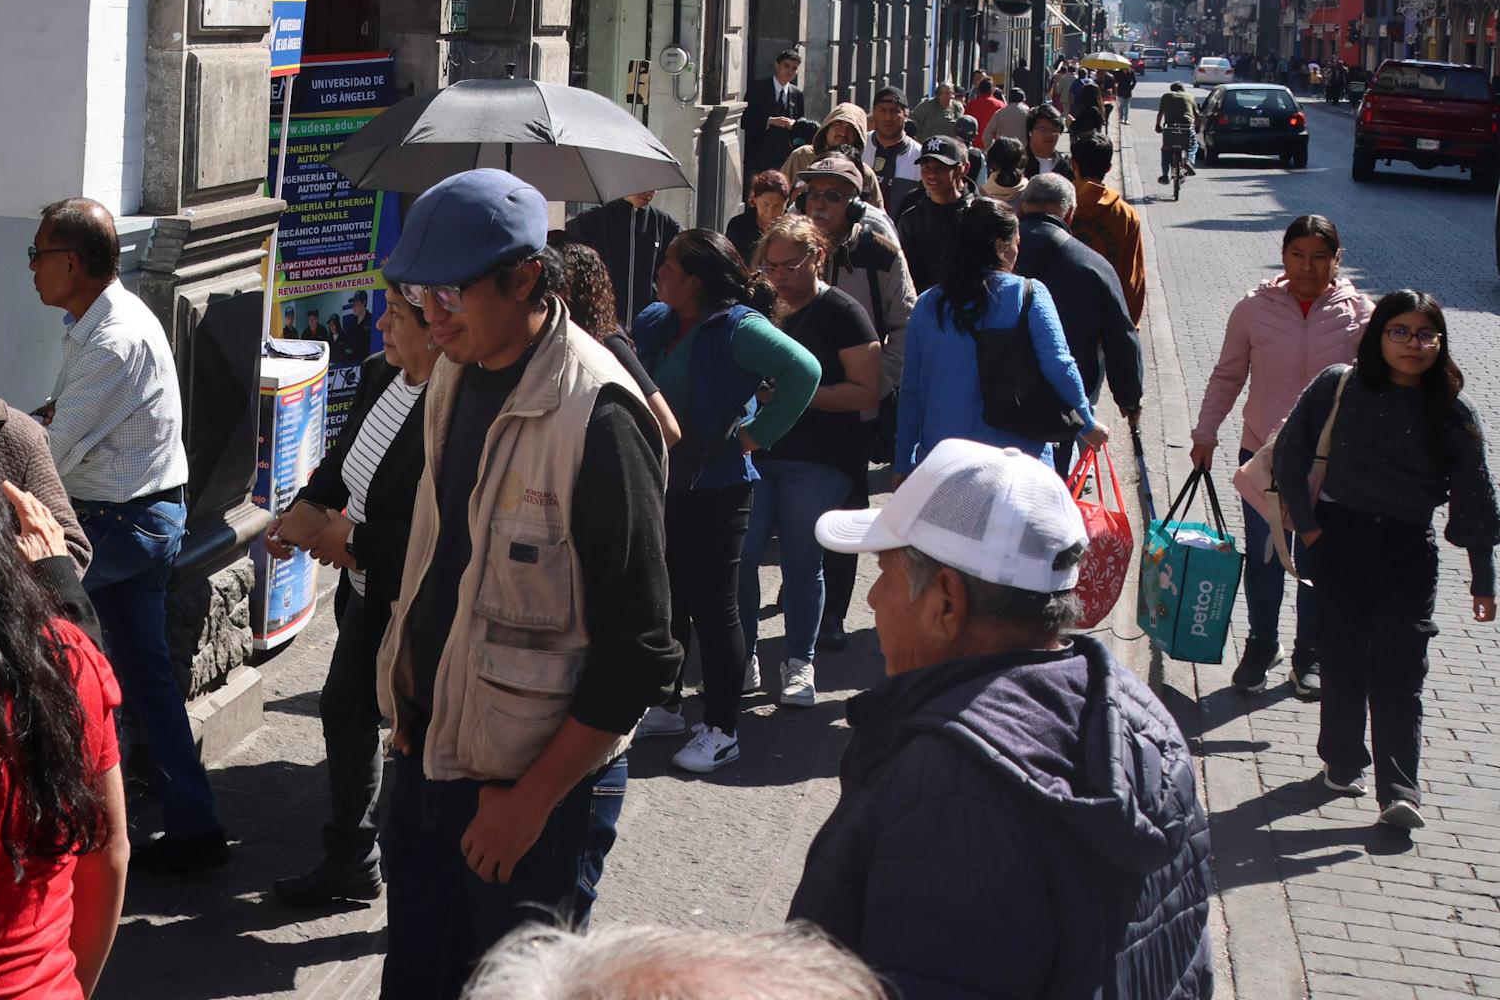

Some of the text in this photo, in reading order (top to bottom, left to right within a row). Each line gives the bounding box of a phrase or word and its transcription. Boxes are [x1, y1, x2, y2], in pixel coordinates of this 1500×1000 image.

[311, 75, 385, 90] UNIVERSIDAD DE
[320, 89, 377, 105] LOS ÁNGELES
[270, 144, 318, 156] INENIERÍA
[320, 142, 333, 151] EN
[326, 171, 338, 181] EN
[325, 200, 336, 210] EN
[339, 196, 375, 208] ENERGÍA
[301, 210, 349, 224] RENOVABLE
[278, 220, 373, 239] MECÁNICO AUTOMOTRIZ
[278, 231, 373, 248] CAPACITACIÓN PARA EL TRABAJO
[275, 251, 376, 271] CAPACITACIÓN EN MECÁNICA
[289, 263, 363, 280] DE MOTOCICLETAS
[278, 276, 375, 296] REVALIDAMOS MATERIAS
[1191, 580, 1214, 637] petco
